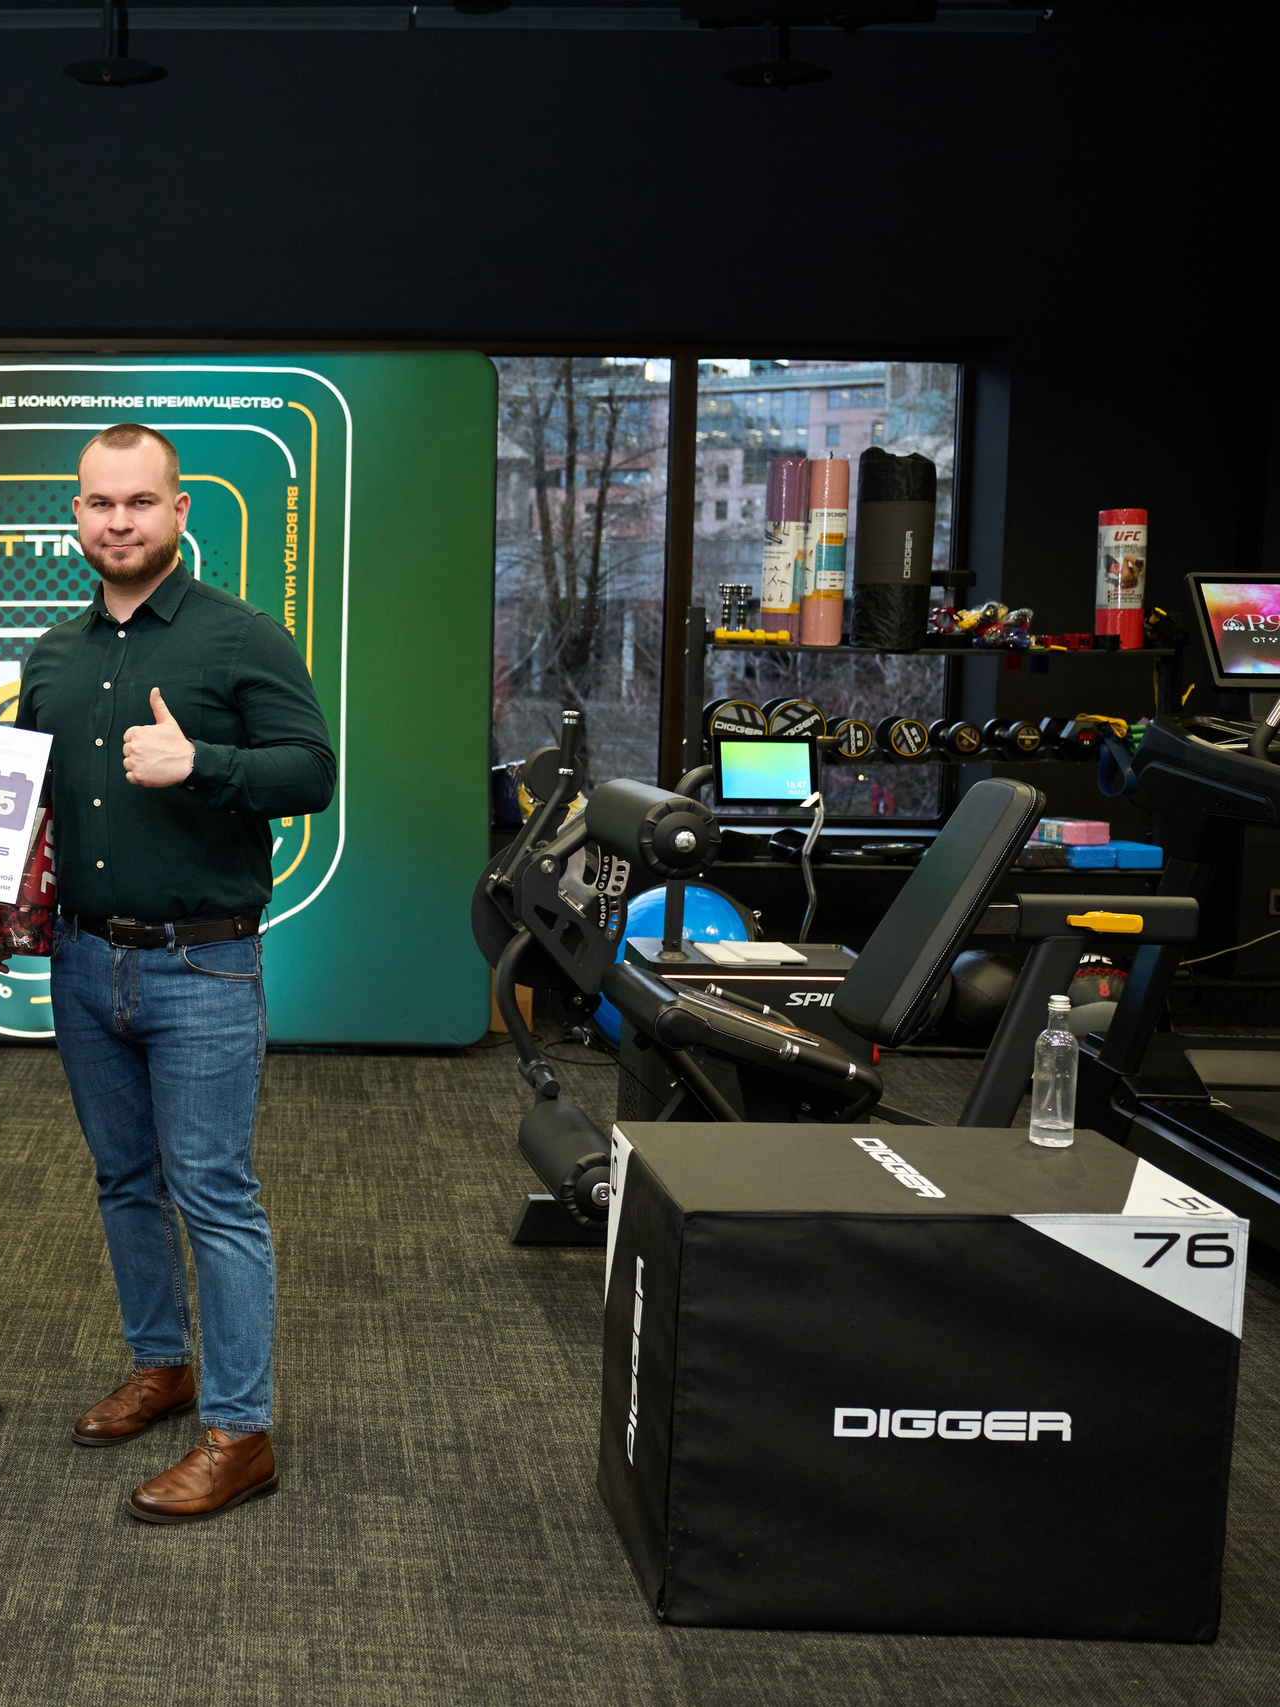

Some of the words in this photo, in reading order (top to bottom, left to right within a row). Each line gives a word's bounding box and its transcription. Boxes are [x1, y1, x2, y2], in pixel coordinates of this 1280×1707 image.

[18, 395, 144, 408] КОНКУРЕНТНОЕ
[147, 396, 283, 410] ПРЕИМУЩЕСТВО
[287, 486, 299, 510] ВЫ
[284, 512, 298, 574] ВСЕГДА
[1114, 531, 1141, 541] UFC
[903, 530, 913, 578] DIGGER
[285, 576, 297, 598] НА
[714, 721, 763, 736] DIGGER
[1099, 982, 1110, 997] 8
[851, 1138, 946, 1199] DIGGER
[1134, 1232, 1235, 1269] 76
[627, 1255, 645, 1467] DIGGER
[833, 1407, 1072, 1442] DIGGER
